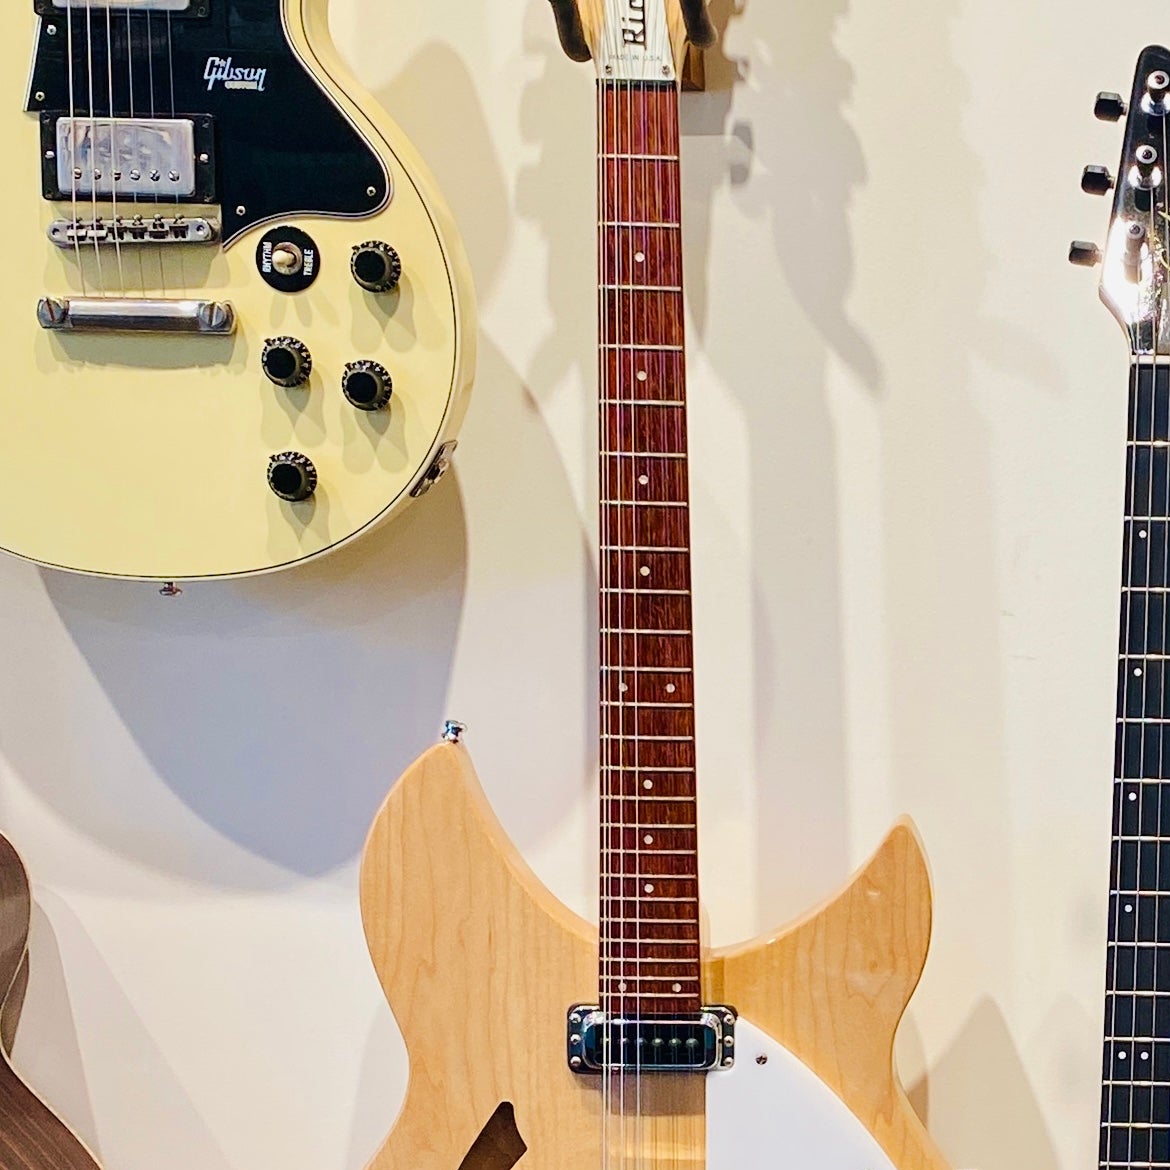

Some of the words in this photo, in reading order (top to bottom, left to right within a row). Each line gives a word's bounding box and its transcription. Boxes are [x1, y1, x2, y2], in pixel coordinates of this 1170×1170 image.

[203, 56, 267, 91] Gibson
[262, 241, 272, 273] RHYTHM
[303, 248, 314, 276] TREBLE
